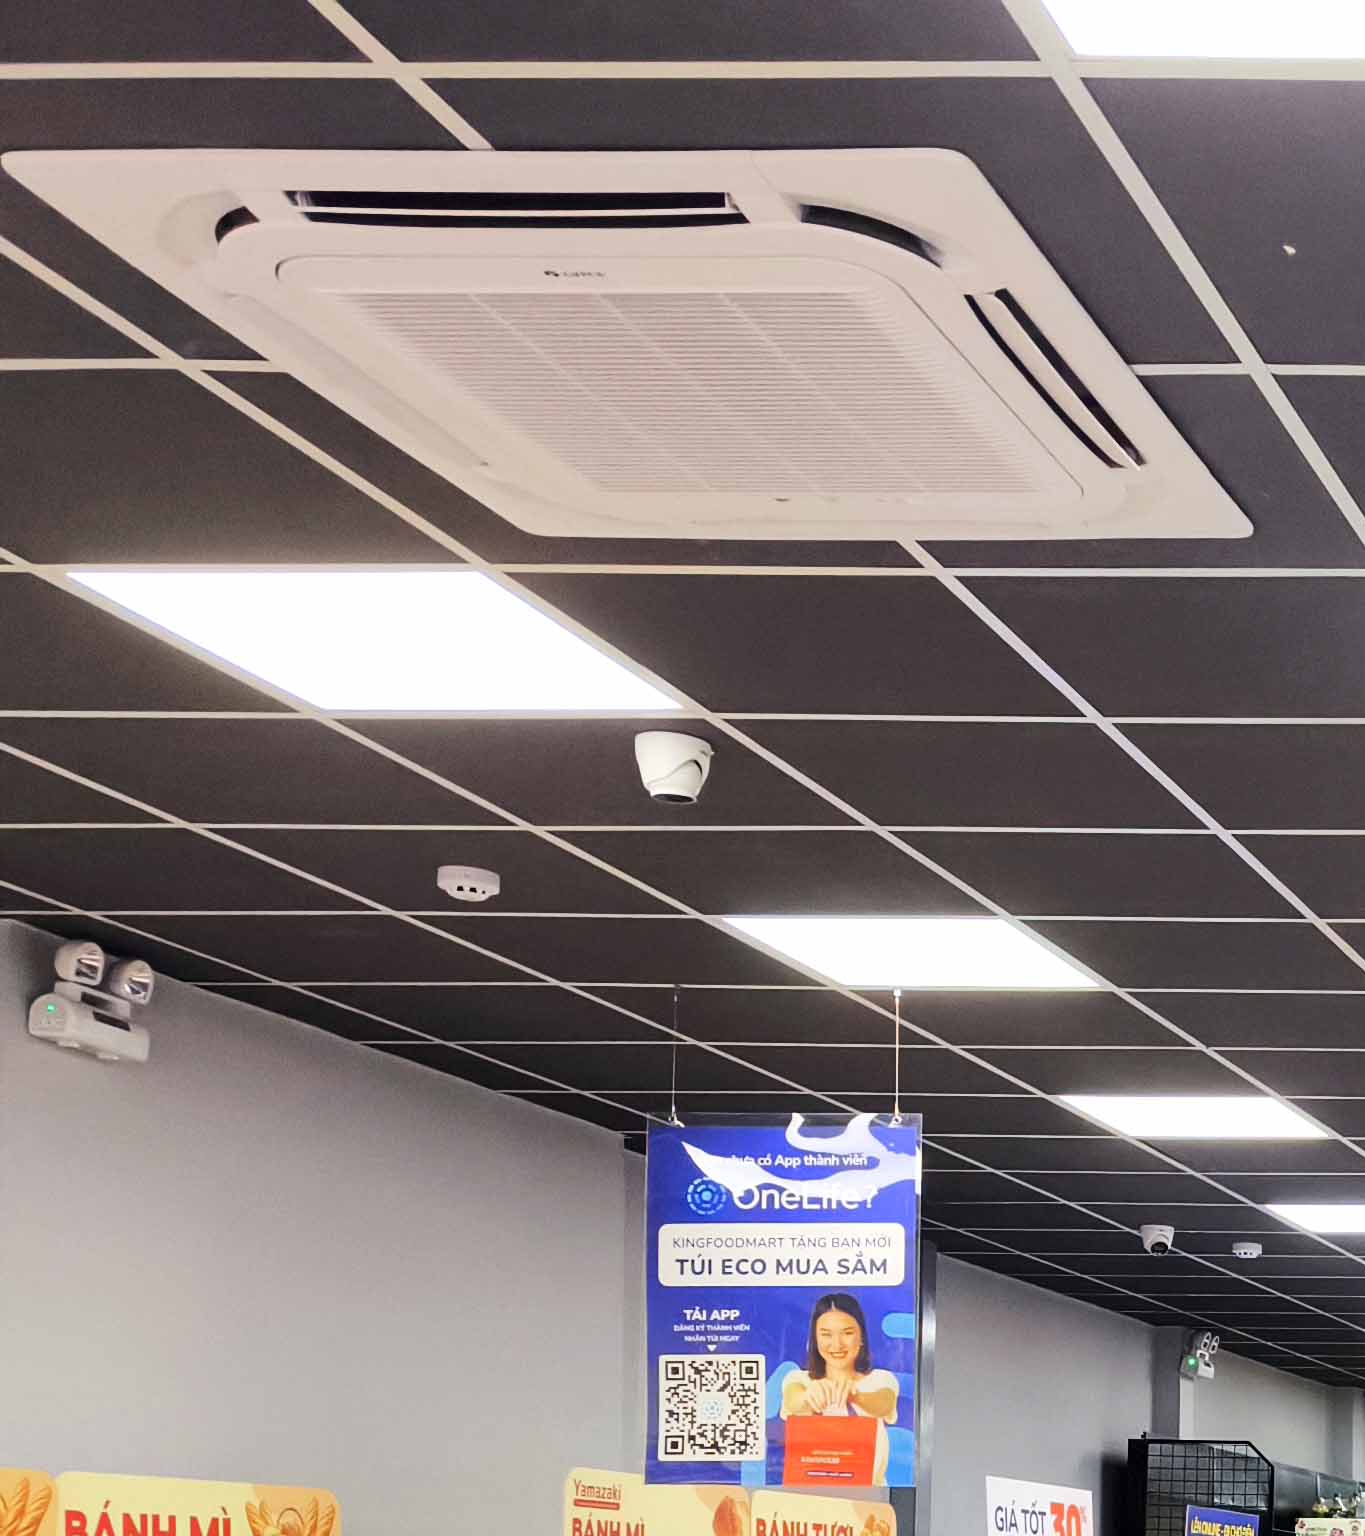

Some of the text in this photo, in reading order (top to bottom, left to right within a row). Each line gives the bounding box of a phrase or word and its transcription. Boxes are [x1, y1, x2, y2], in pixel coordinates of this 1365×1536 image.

[774, 1155, 801, 1169] App
[672, 1236, 784, 1250] KINGFOODMART
[676, 1252, 888, 1276] TÚI ECO MUA SẮM
[710, 1309, 740, 1321] APP
[574, 1479, 622, 1501] Yamazaki
[995, 1504, 1018, 1534] GIÁ
